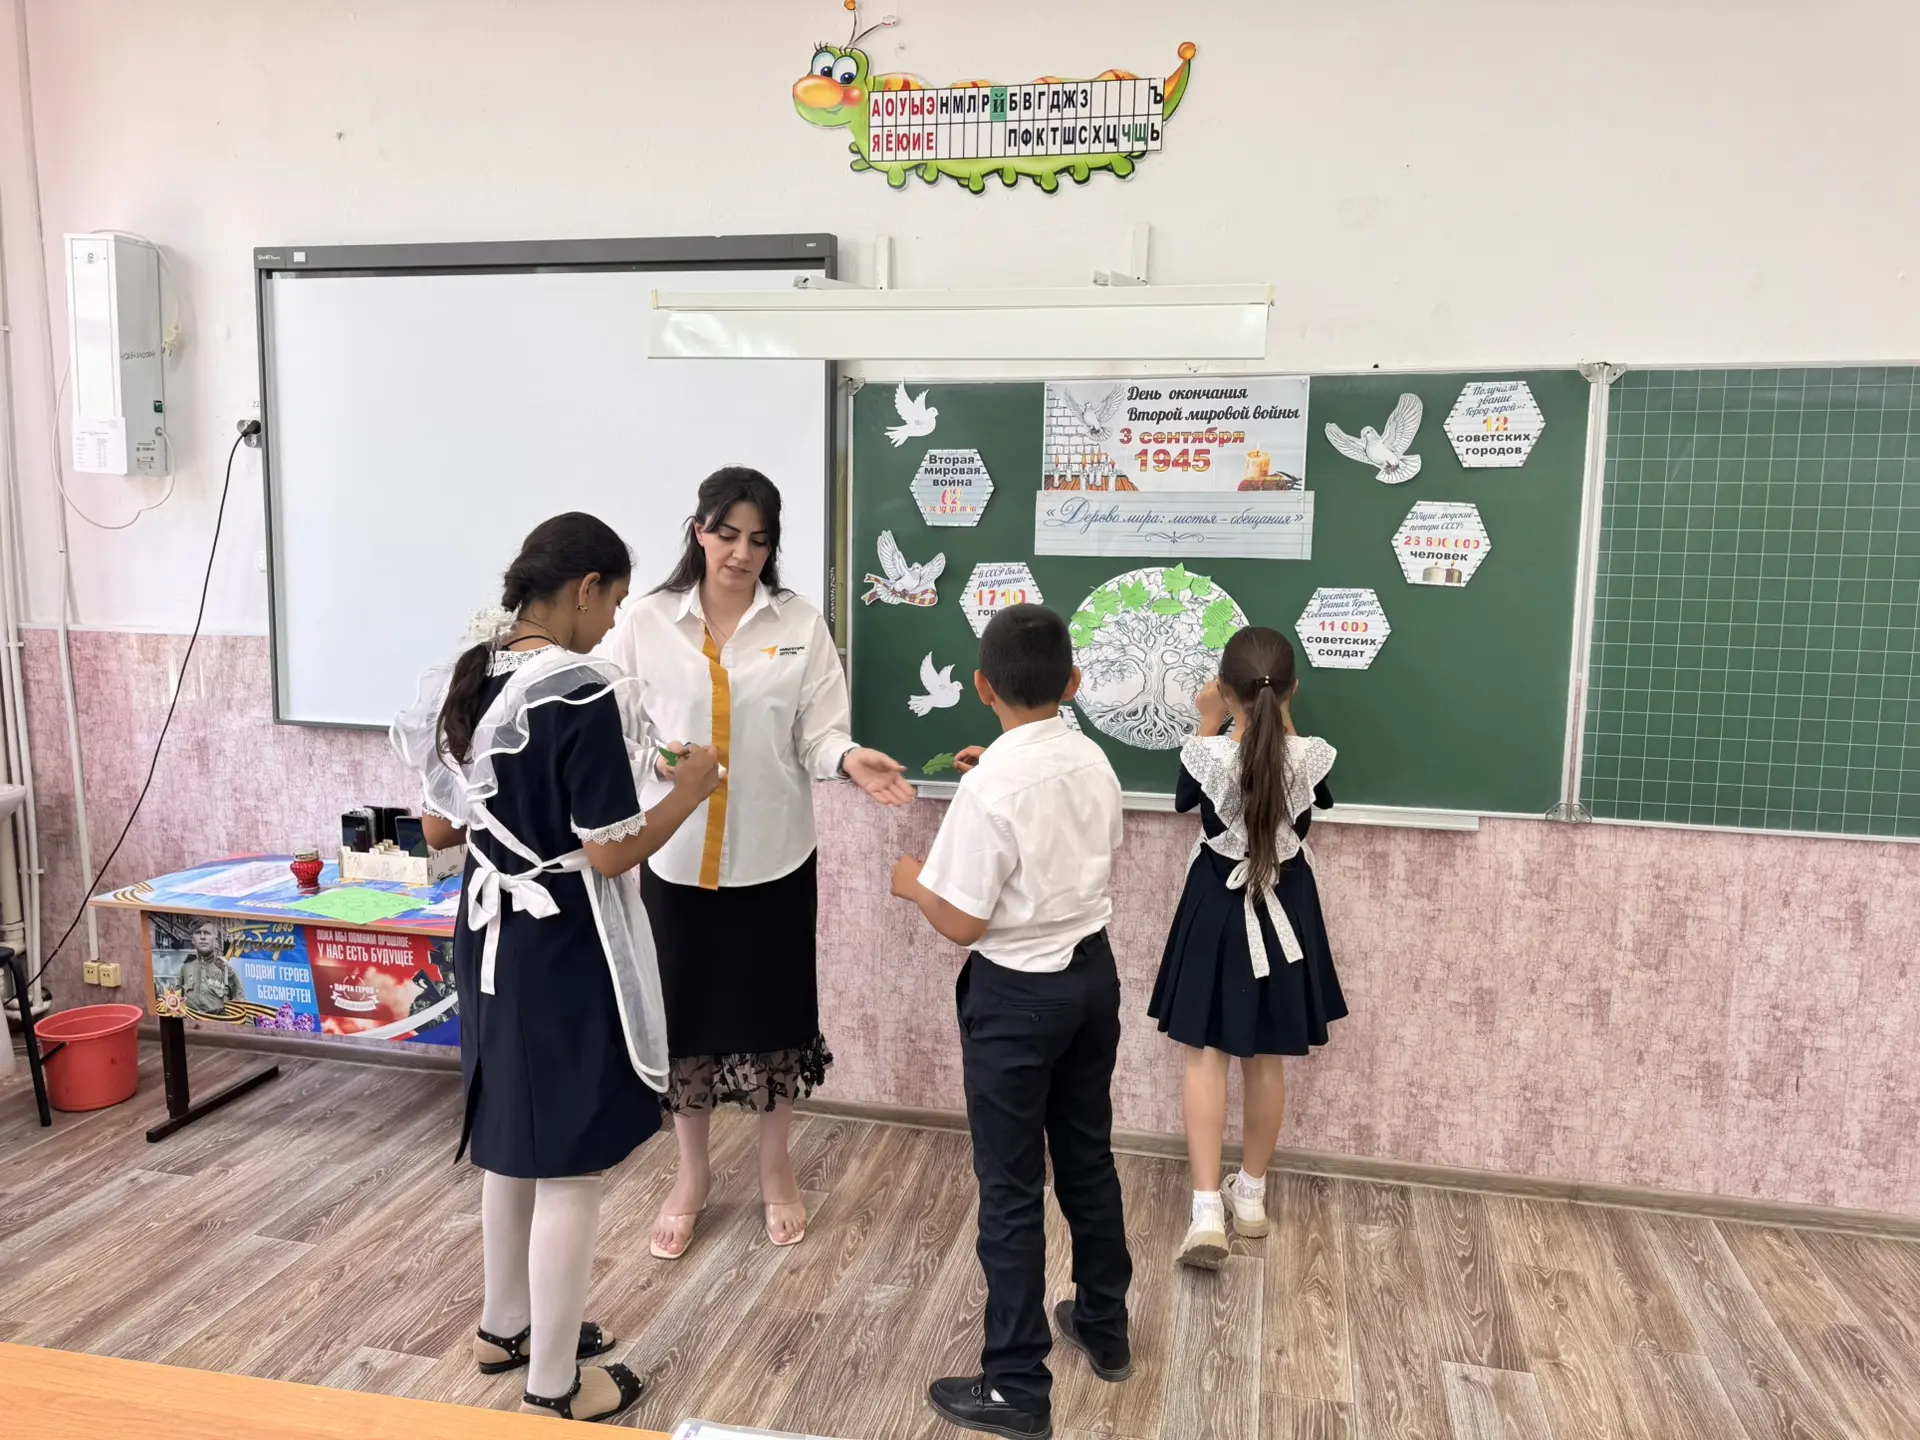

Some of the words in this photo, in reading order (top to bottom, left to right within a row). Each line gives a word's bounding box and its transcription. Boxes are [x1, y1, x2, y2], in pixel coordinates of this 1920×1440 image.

[1127, 386, 1162, 401] День
[1169, 387, 1248, 400] окончания
[1477, 395, 1512, 408] звание
[1127, 407, 1183, 425] Второй
[1185, 405, 1250, 424] мировой
[1253, 405, 1300, 419] войны
[1482, 416, 1508, 432] 12
[1119, 428, 1132, 445] 3
[1139, 427, 1245, 447] сентября
[1457, 434, 1531, 442] советских
[1466, 447, 1522, 457] городов
[929, 455, 975, 466] Вторая
[1134, 448, 1211, 472] 1945
[924, 467, 981, 476] мировая
[933, 477, 972, 486] война
[1122, 510, 1165, 532] мира:
[1168, 515, 1217, 525] листья
[1438, 512, 1473, 521] людские
[1409, 524, 1438, 532] потери
[1440, 522, 1464, 530] СССР:
[1410, 550, 1468, 561] человек
[985, 568, 1005, 578] СССР
[974, 589, 1026, 606] 1710
[1318, 601, 1350, 612] звания
[1352, 599, 1376, 608] Героя
[1307, 610, 1350, 618] Советского
[1319, 621, 1335, 631] 11
[1341, 622, 1368, 632] 000
[1307, 636, 1377, 646] советских
[1318, 649, 1365, 658] солдат
[225, 924, 296, 961] Победа
[316, 929, 333, 941] ПОКА
[335, 931, 347, 942] МЫ
[348, 932, 377, 944] ПОМНИМ
[317, 943, 323, 958] У
[326, 943, 343, 959] НАС
[346, 945, 368, 961] ЕСТЬ
[371, 948, 414, 967] БУДУЩЕЕ
[244, 964, 276, 980] ПОДВИГ
[279, 967, 309, 983] ГЕРОЕВ
[257, 985, 311, 1003] БЕССМЕРТЕН
